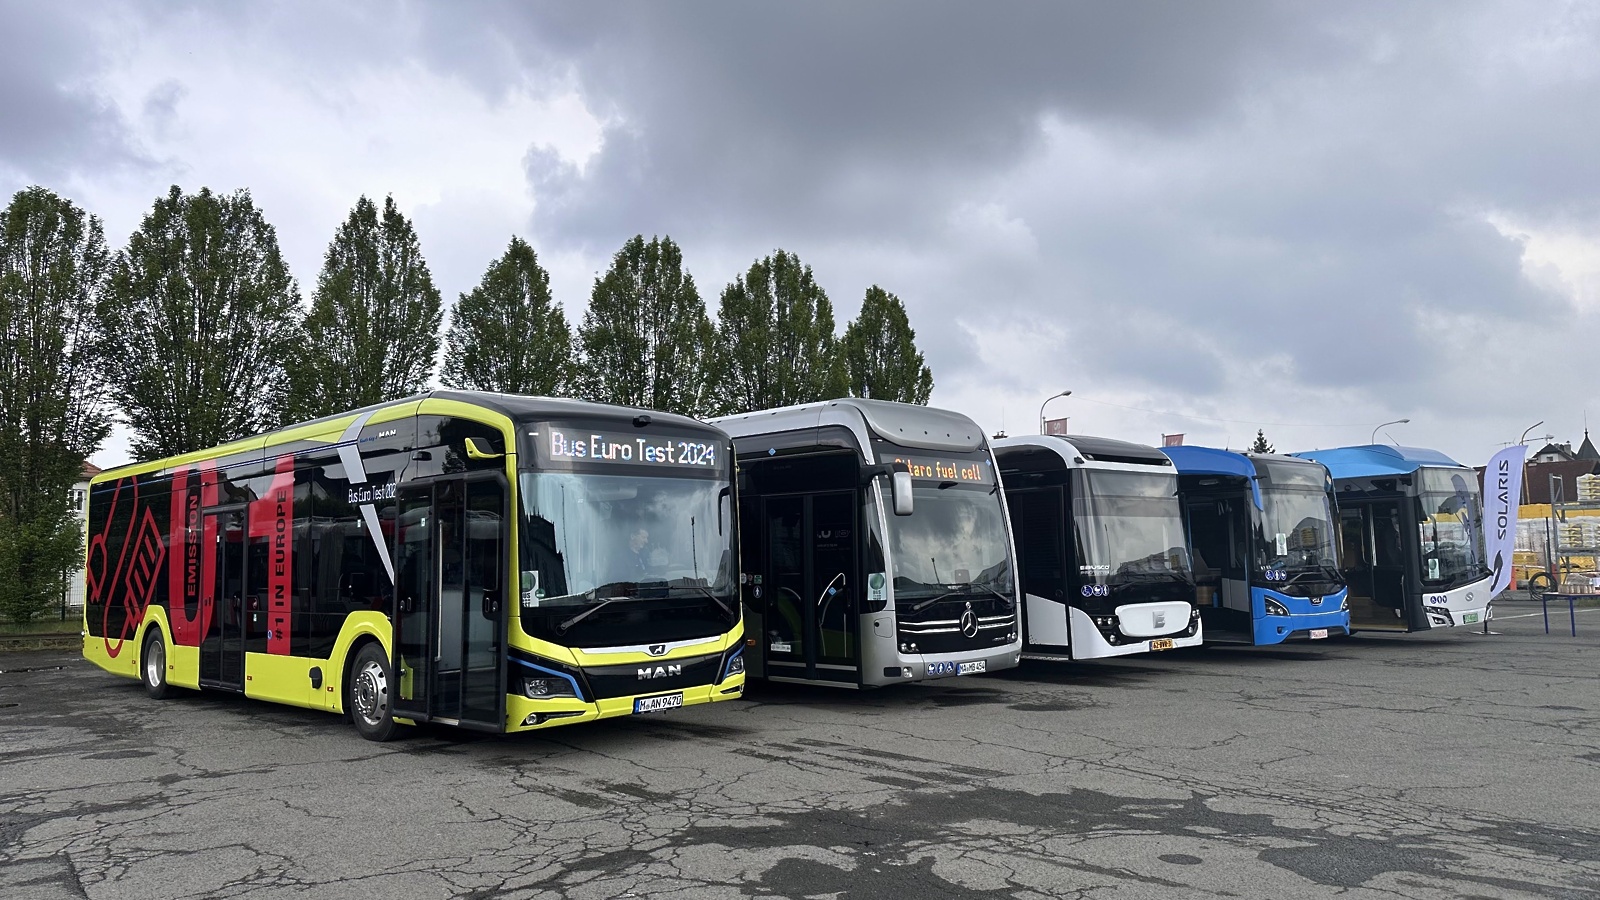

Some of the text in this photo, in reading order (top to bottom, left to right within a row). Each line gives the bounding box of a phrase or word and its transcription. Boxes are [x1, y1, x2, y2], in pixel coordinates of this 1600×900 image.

[378, 429, 397, 438] MAN
[551, 431, 716, 466] Bus Euro Test 2024
[894, 457, 982, 480] taro fuel cell
[348, 482, 397, 503] Bus Euro Test 202
[1497, 459, 1509, 540] SOLARIS
[187, 495, 199, 596] EMISSION
[275, 490, 287, 640] #1 IN EUROPE
[637, 664, 682, 681] MAN
[662, 695, 682, 708] 9470
